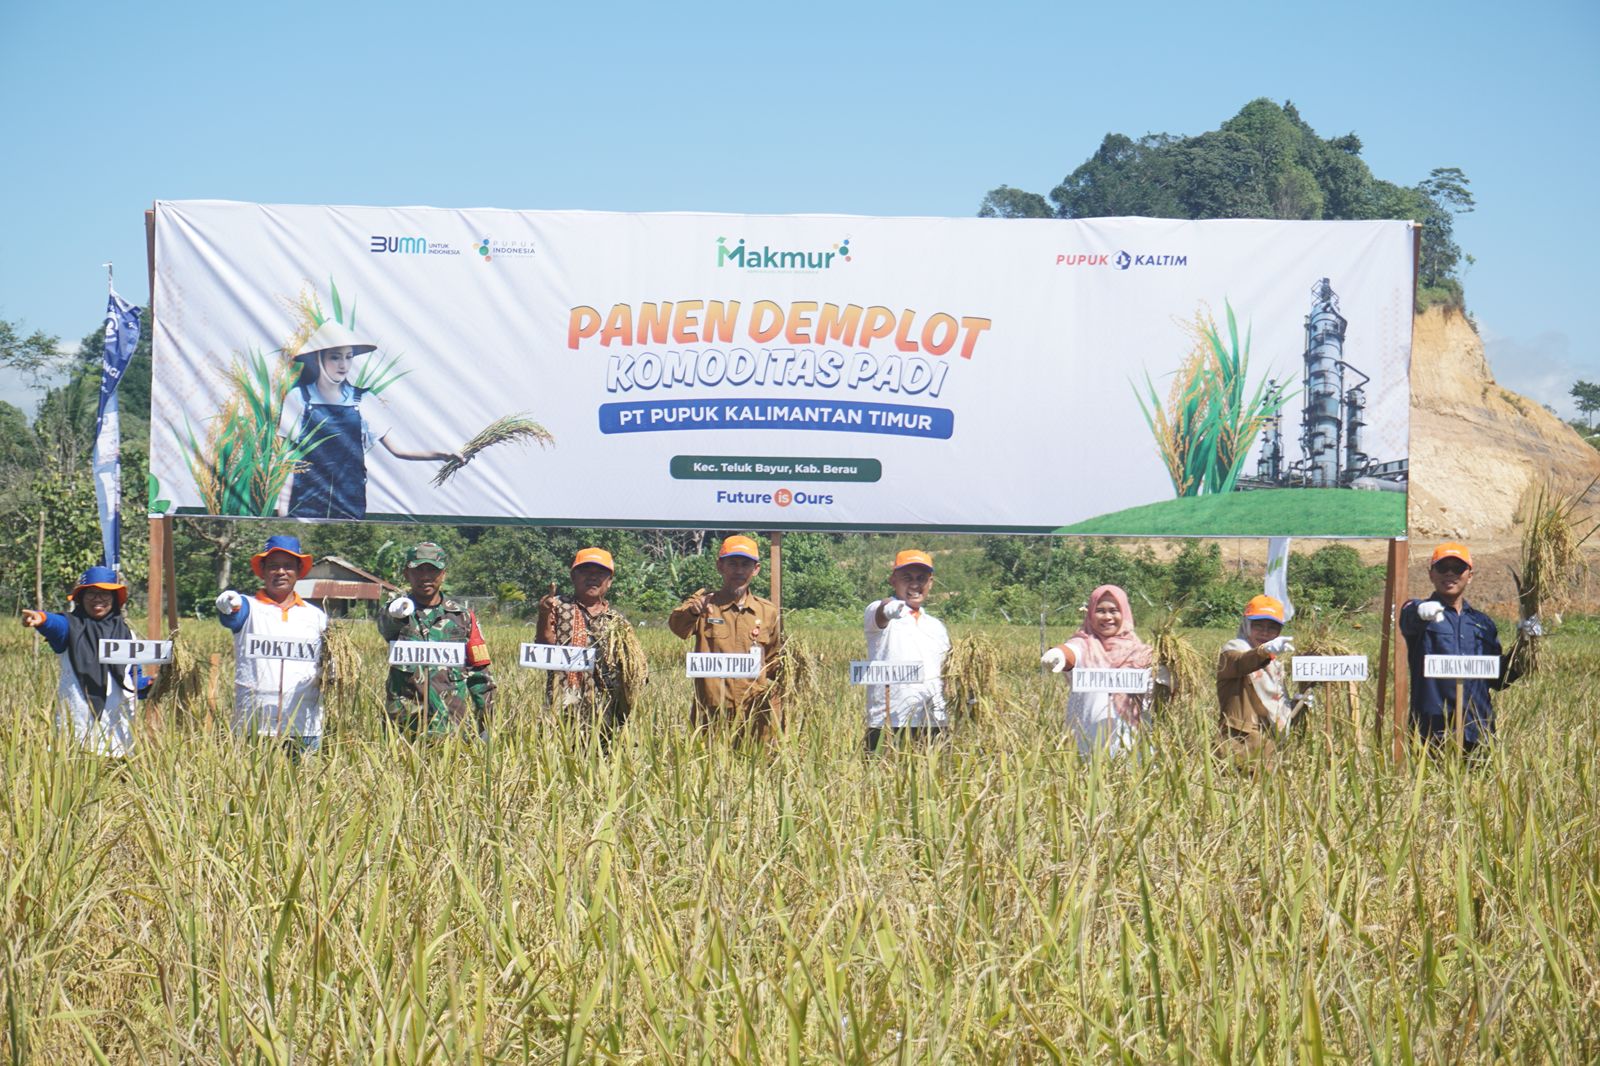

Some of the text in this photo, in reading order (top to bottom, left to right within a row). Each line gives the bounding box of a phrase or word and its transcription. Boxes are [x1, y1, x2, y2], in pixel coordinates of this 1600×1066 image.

[371, 236, 426, 254] BUMN
[717, 238, 835, 269] Makmur
[1056, 254, 1188, 266] PUPUK KALTIM
[568, 300, 992, 360] PANEN DEMPLOT
[606, 348, 949, 398] KOMODITAS PADI
[619, 405, 933, 431] PT PUPUK KALIMANTAN TIMUR
[693, 462, 858, 475] Kec. Teluk Bayur, Kab. Berau
[716, 490, 834, 505] Future is Ours
[249, 639, 318, 660] POKTAN
[393, 646, 460, 664] BABINSA
[690, 656, 755, 673] KADIS TPHP
